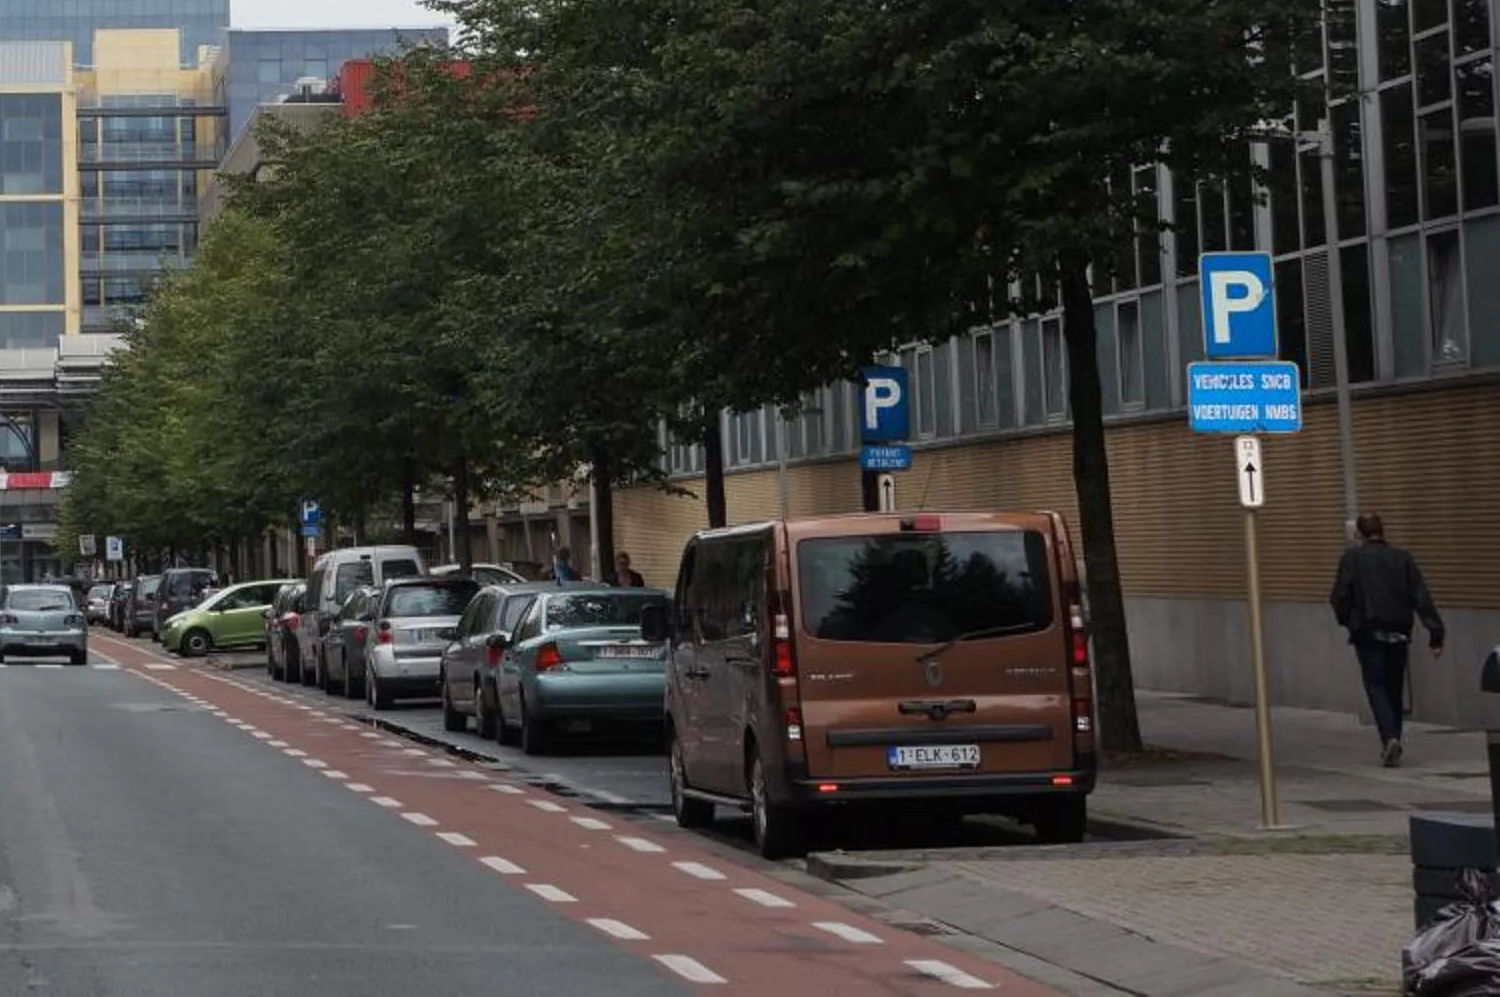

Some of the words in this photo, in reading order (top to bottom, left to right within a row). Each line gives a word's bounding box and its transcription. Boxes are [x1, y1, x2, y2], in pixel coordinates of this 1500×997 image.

[1209, 271, 1264, 343] P
[1261, 373, 1291, 390] SNCB
[865, 378, 901, 429] P
[1193, 404, 1259, 420] VOERTUIGEN
[1265, 404, 1297, 420] NMBS
